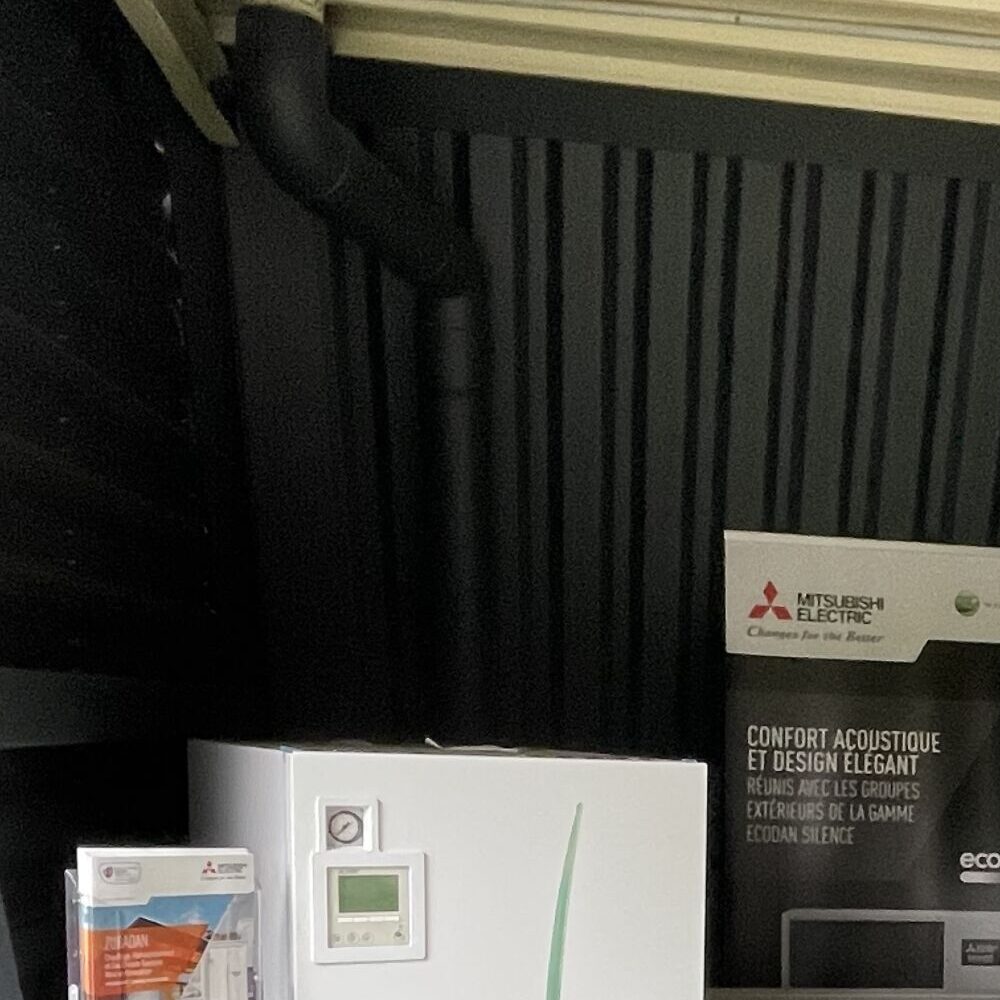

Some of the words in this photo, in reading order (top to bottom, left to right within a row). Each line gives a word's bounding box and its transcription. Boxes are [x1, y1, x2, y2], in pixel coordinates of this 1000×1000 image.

[797, 592, 884, 611] MITSUBISHI
[797, 607, 872, 624] ELECTRIC
[747, 725, 828, 749] CONFORT
[833, 727, 941, 753] ACOUSTIQUE
[748, 749, 767, 771] ET
[773, 750, 838, 773] DESIGN
[747, 775, 793, 797] RÉUNIS
[799, 778, 830, 797] AVEC
[834, 779, 857, 798] LES
[861, 780, 920, 800] GROUPES
[829, 802, 844, 821] DE
[850, 803, 864, 821] LA
[868, 804, 914, 823] GAMME
[747, 824, 798, 843] ECODAN
[802, 825, 855, 845] SILENCE
